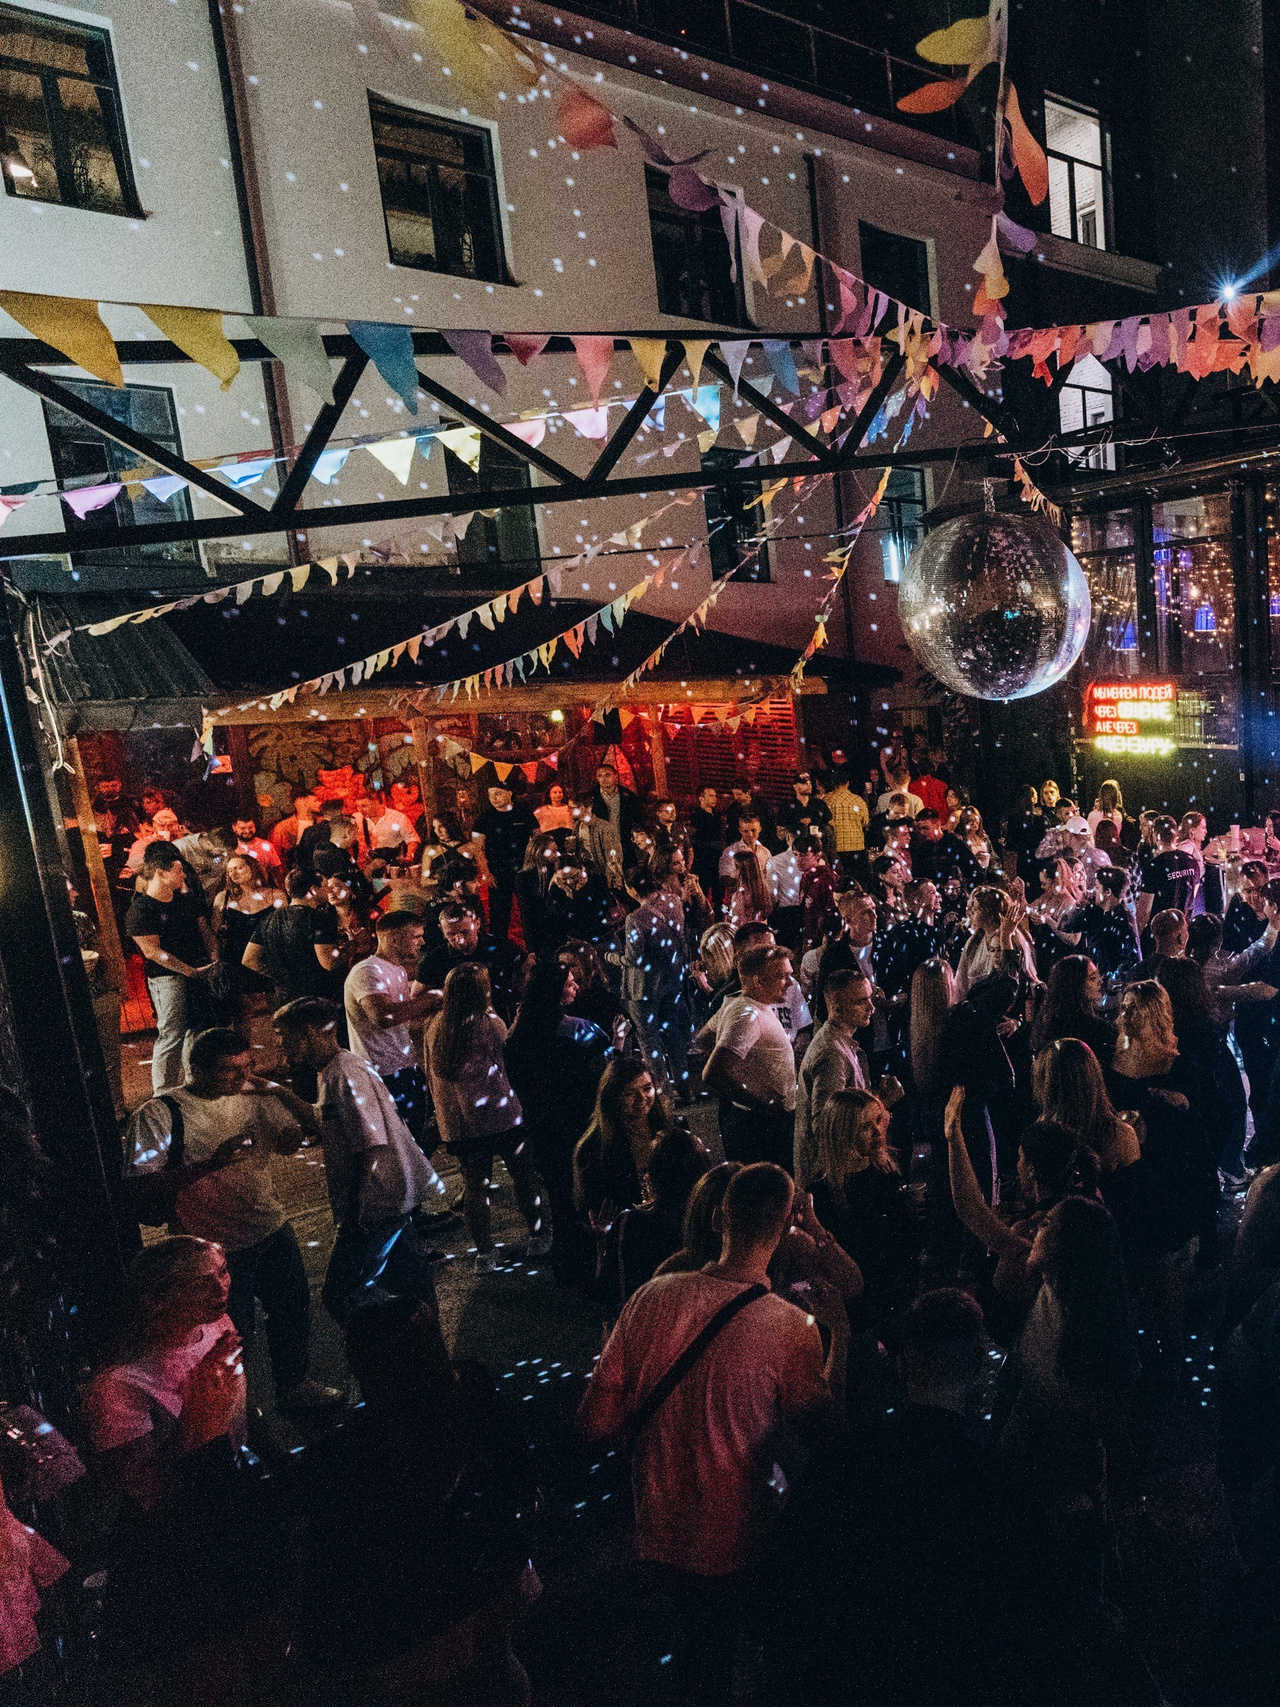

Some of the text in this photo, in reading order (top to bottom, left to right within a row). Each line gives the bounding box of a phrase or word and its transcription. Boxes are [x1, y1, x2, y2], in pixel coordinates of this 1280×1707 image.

[1138, 684, 1172, 701] ЛЮДЕЙ
[1094, 705, 1117, 718] ЧЕРЕЗ
[1113, 721, 1137, 734] ЧЕРЕЗ
[1166, 868, 1196, 881] SECURITY
